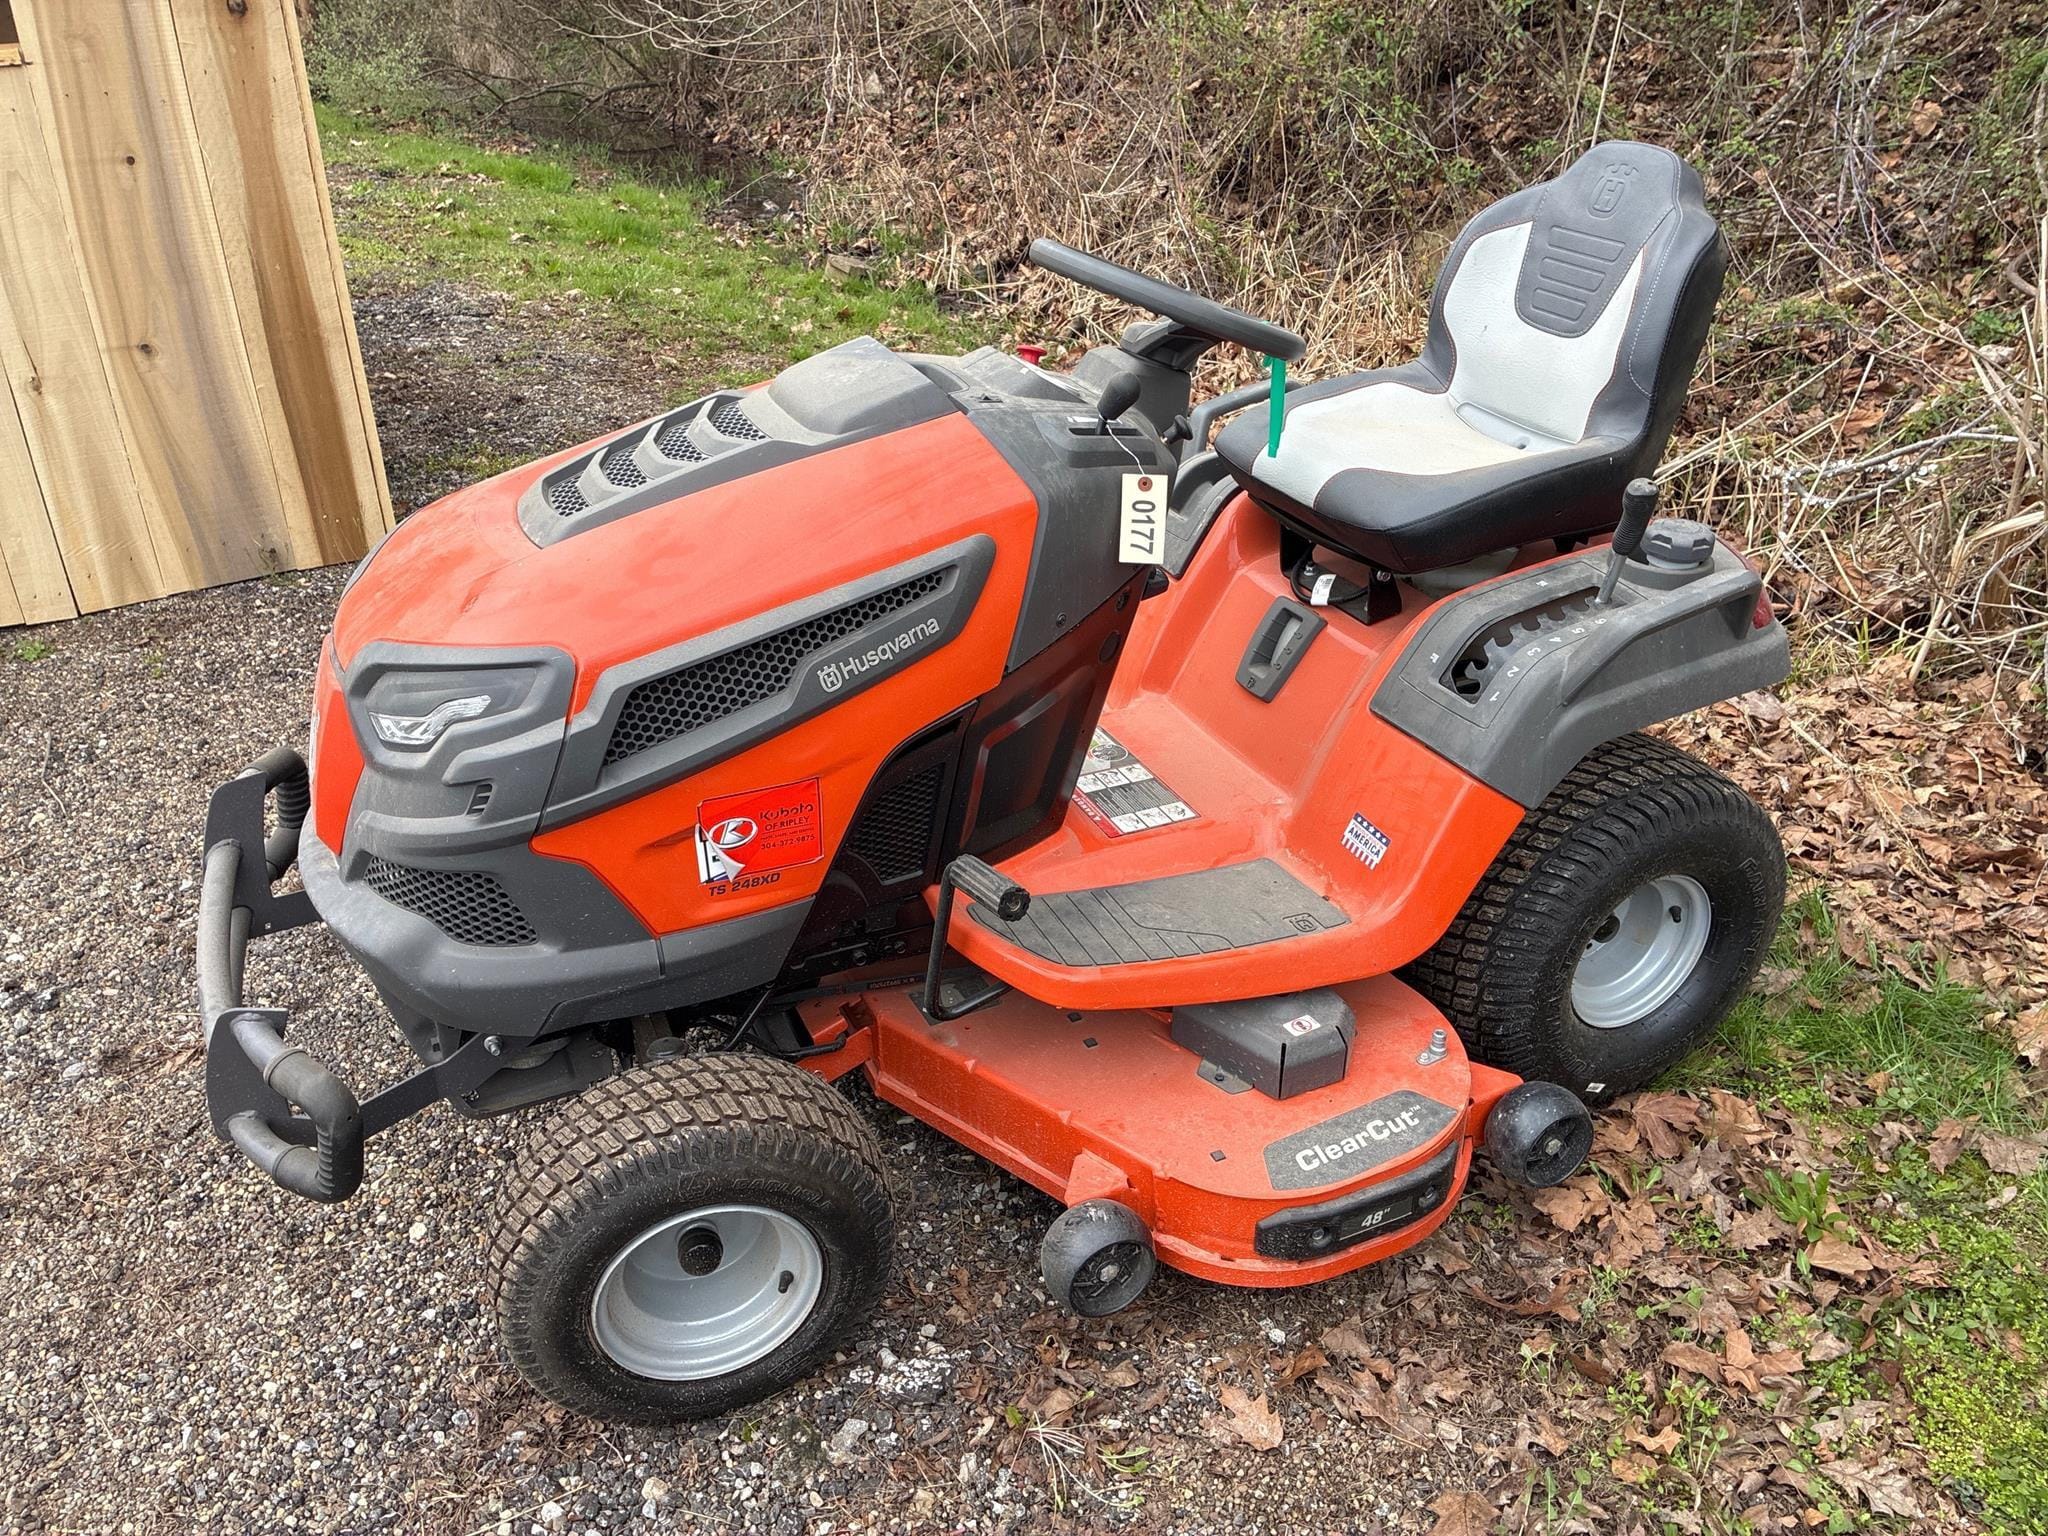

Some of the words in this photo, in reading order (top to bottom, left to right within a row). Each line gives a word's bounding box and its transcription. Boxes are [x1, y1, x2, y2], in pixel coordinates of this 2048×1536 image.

[1130, 500, 1156, 554] 0177
[840, 618, 940, 680] Husqvarna
[1489, 691, 1500, 702] 1
[1507, 666, 1520, 677] 2
[1527, 647, 1541, 657] 3
[760, 803, 814, 820] Kubota
[765, 821, 779, 831] OF
[780, 815, 810, 828] RIPLEY
[1348, 827, 1381, 858] AMERICA
[709, 885, 726, 896] TS
[731, 872, 780, 892] 248XD
